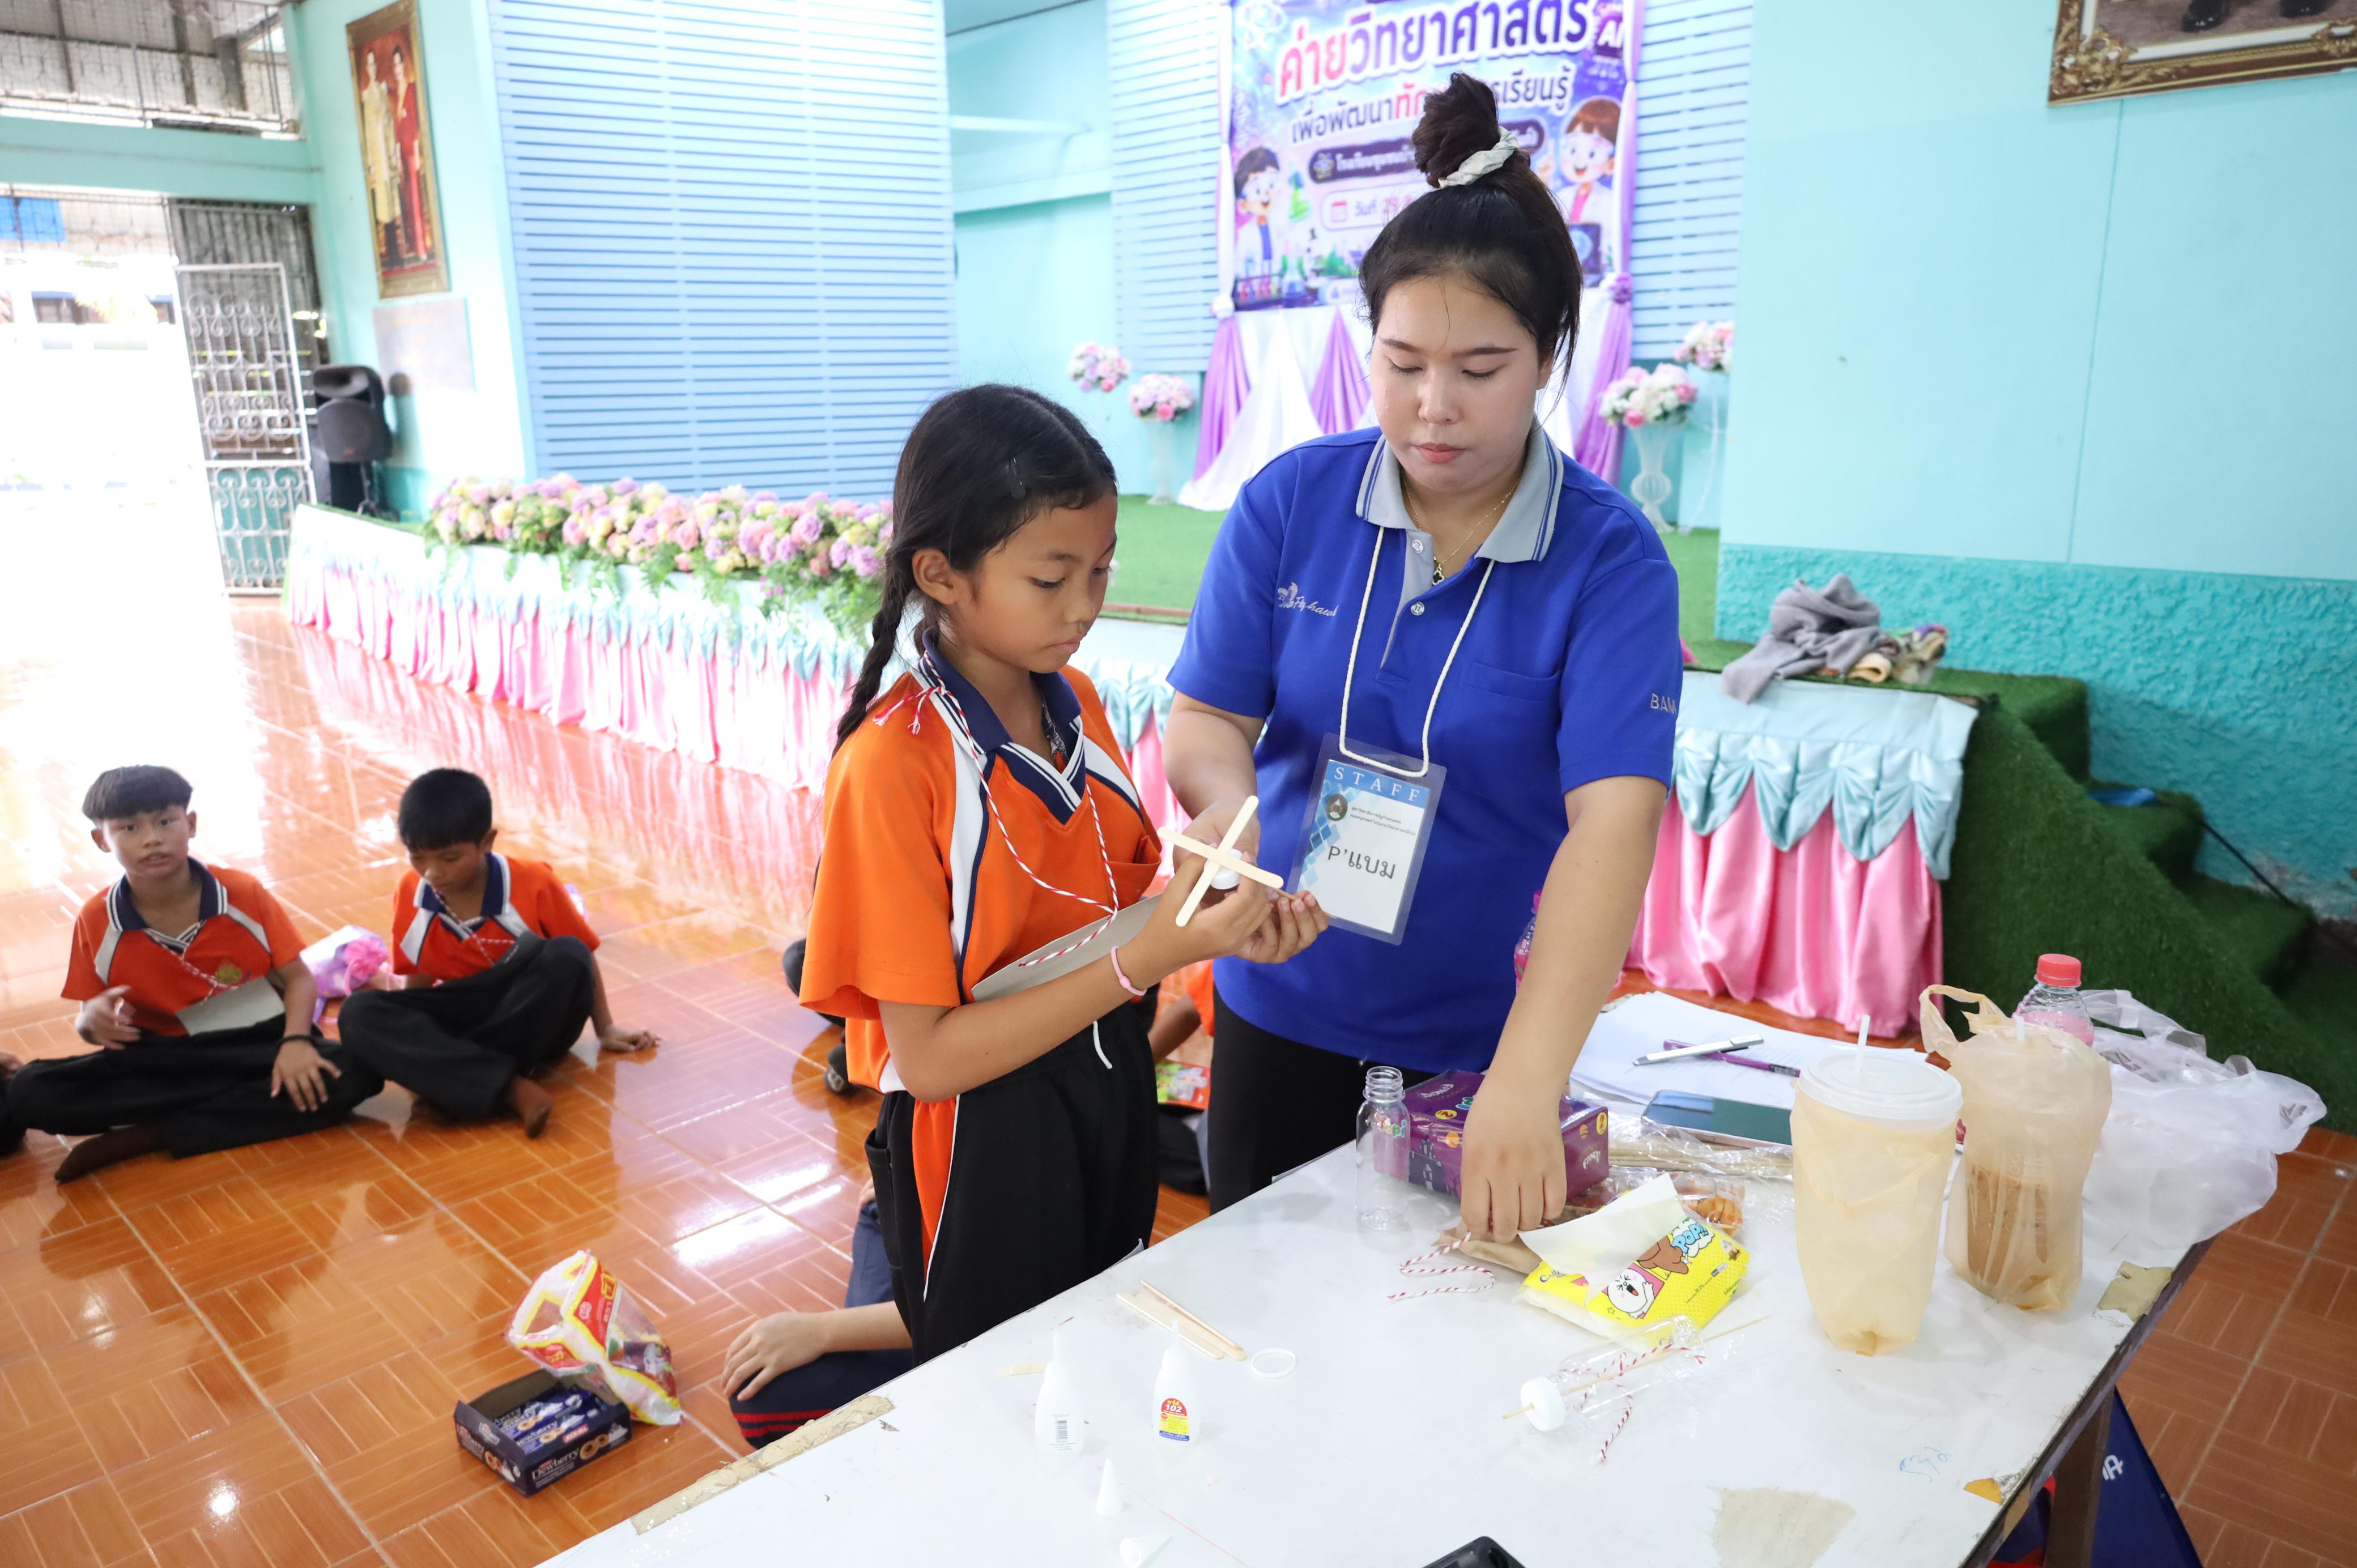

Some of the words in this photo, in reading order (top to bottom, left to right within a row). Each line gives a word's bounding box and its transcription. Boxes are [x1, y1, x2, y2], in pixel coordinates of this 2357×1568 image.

[1280, 0, 1586, 97] ค่ายวิทยาศาสตร
[1334, 766, 1419, 802] STAFF
[1165, 1404, 1182, 1413] 102
